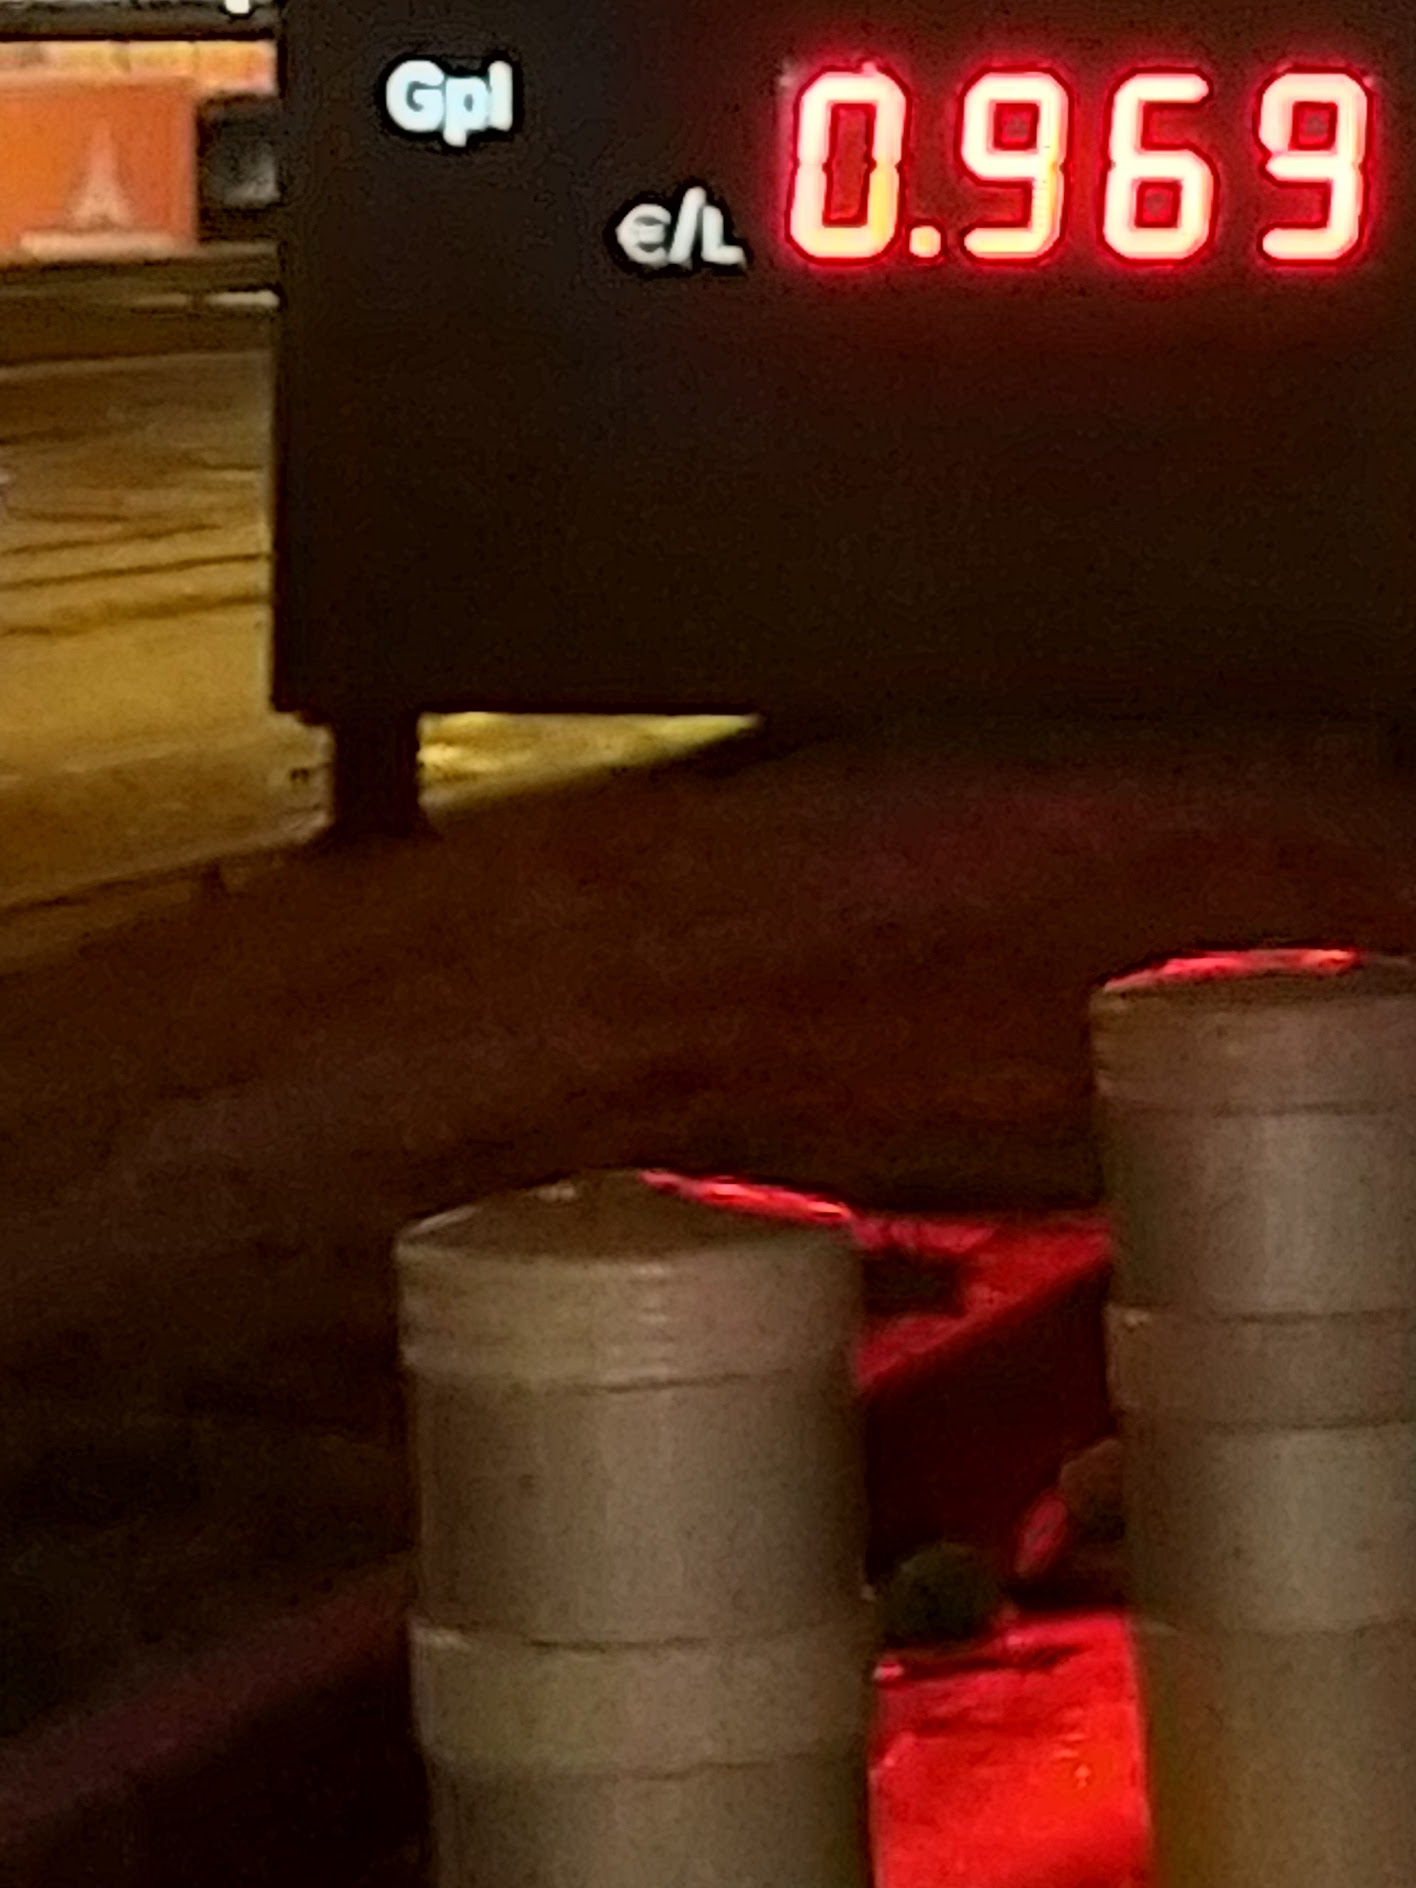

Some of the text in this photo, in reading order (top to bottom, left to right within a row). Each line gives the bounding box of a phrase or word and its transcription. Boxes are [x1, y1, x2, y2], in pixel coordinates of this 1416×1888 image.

[384, 59, 1371, 262] Gpl 0.969
[615, 186, 745, 266] €/L
